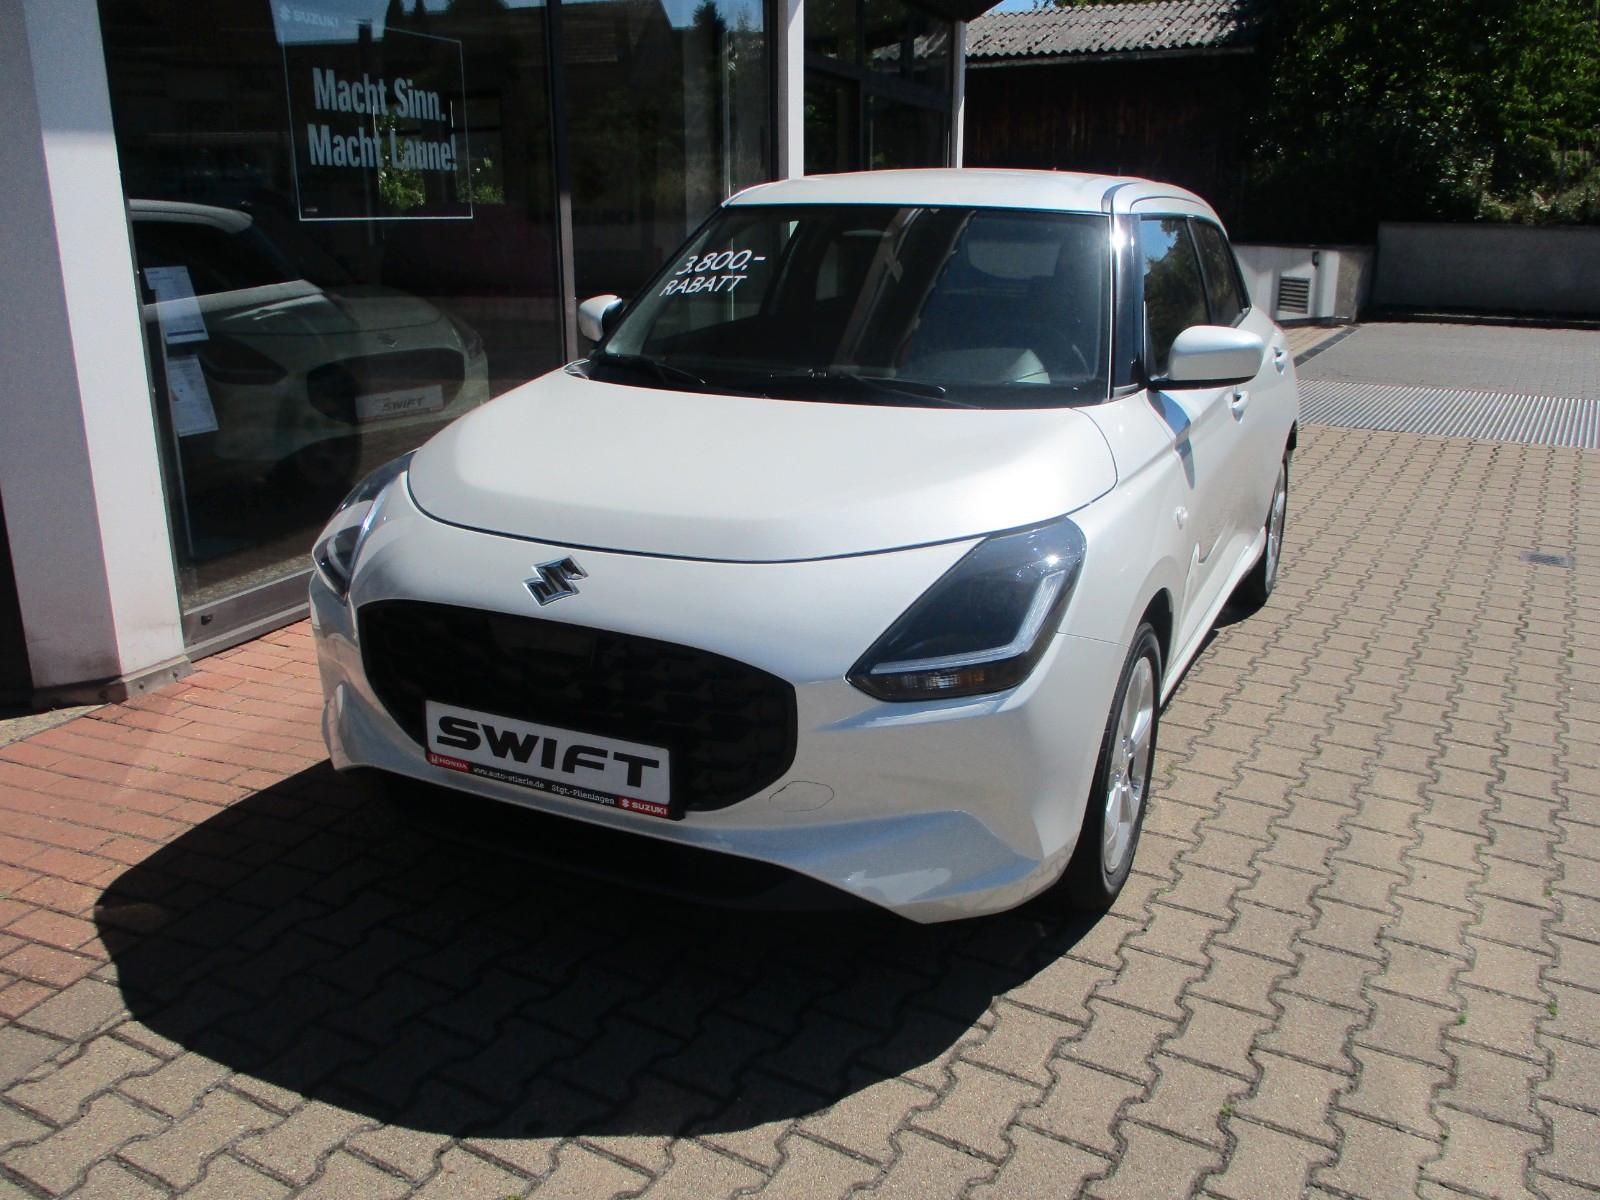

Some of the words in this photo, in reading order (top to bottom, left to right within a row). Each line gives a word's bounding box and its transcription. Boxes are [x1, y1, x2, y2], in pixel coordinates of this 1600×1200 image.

[293, 10, 338, 27] SUZUKI
[312, 67, 388, 116] Macht
[393, 78, 447, 122] Sinn.
[307, 123, 384, 168] Macht
[389, 130, 458, 172] Laune!
[675, 249, 766, 276] 3.800,-
[659, 275, 748, 297] RABATT
[382, 396, 424, 412] SWIFT
[436, 715, 660, 788] SWIFT
[438, 757, 469, 770] HONDA
[472, 766, 545, 789] www.auto-stierle.de
[551, 784, 615, 806] Stgt.-Plieningen
[631, 801, 667, 816] SUZUKI
